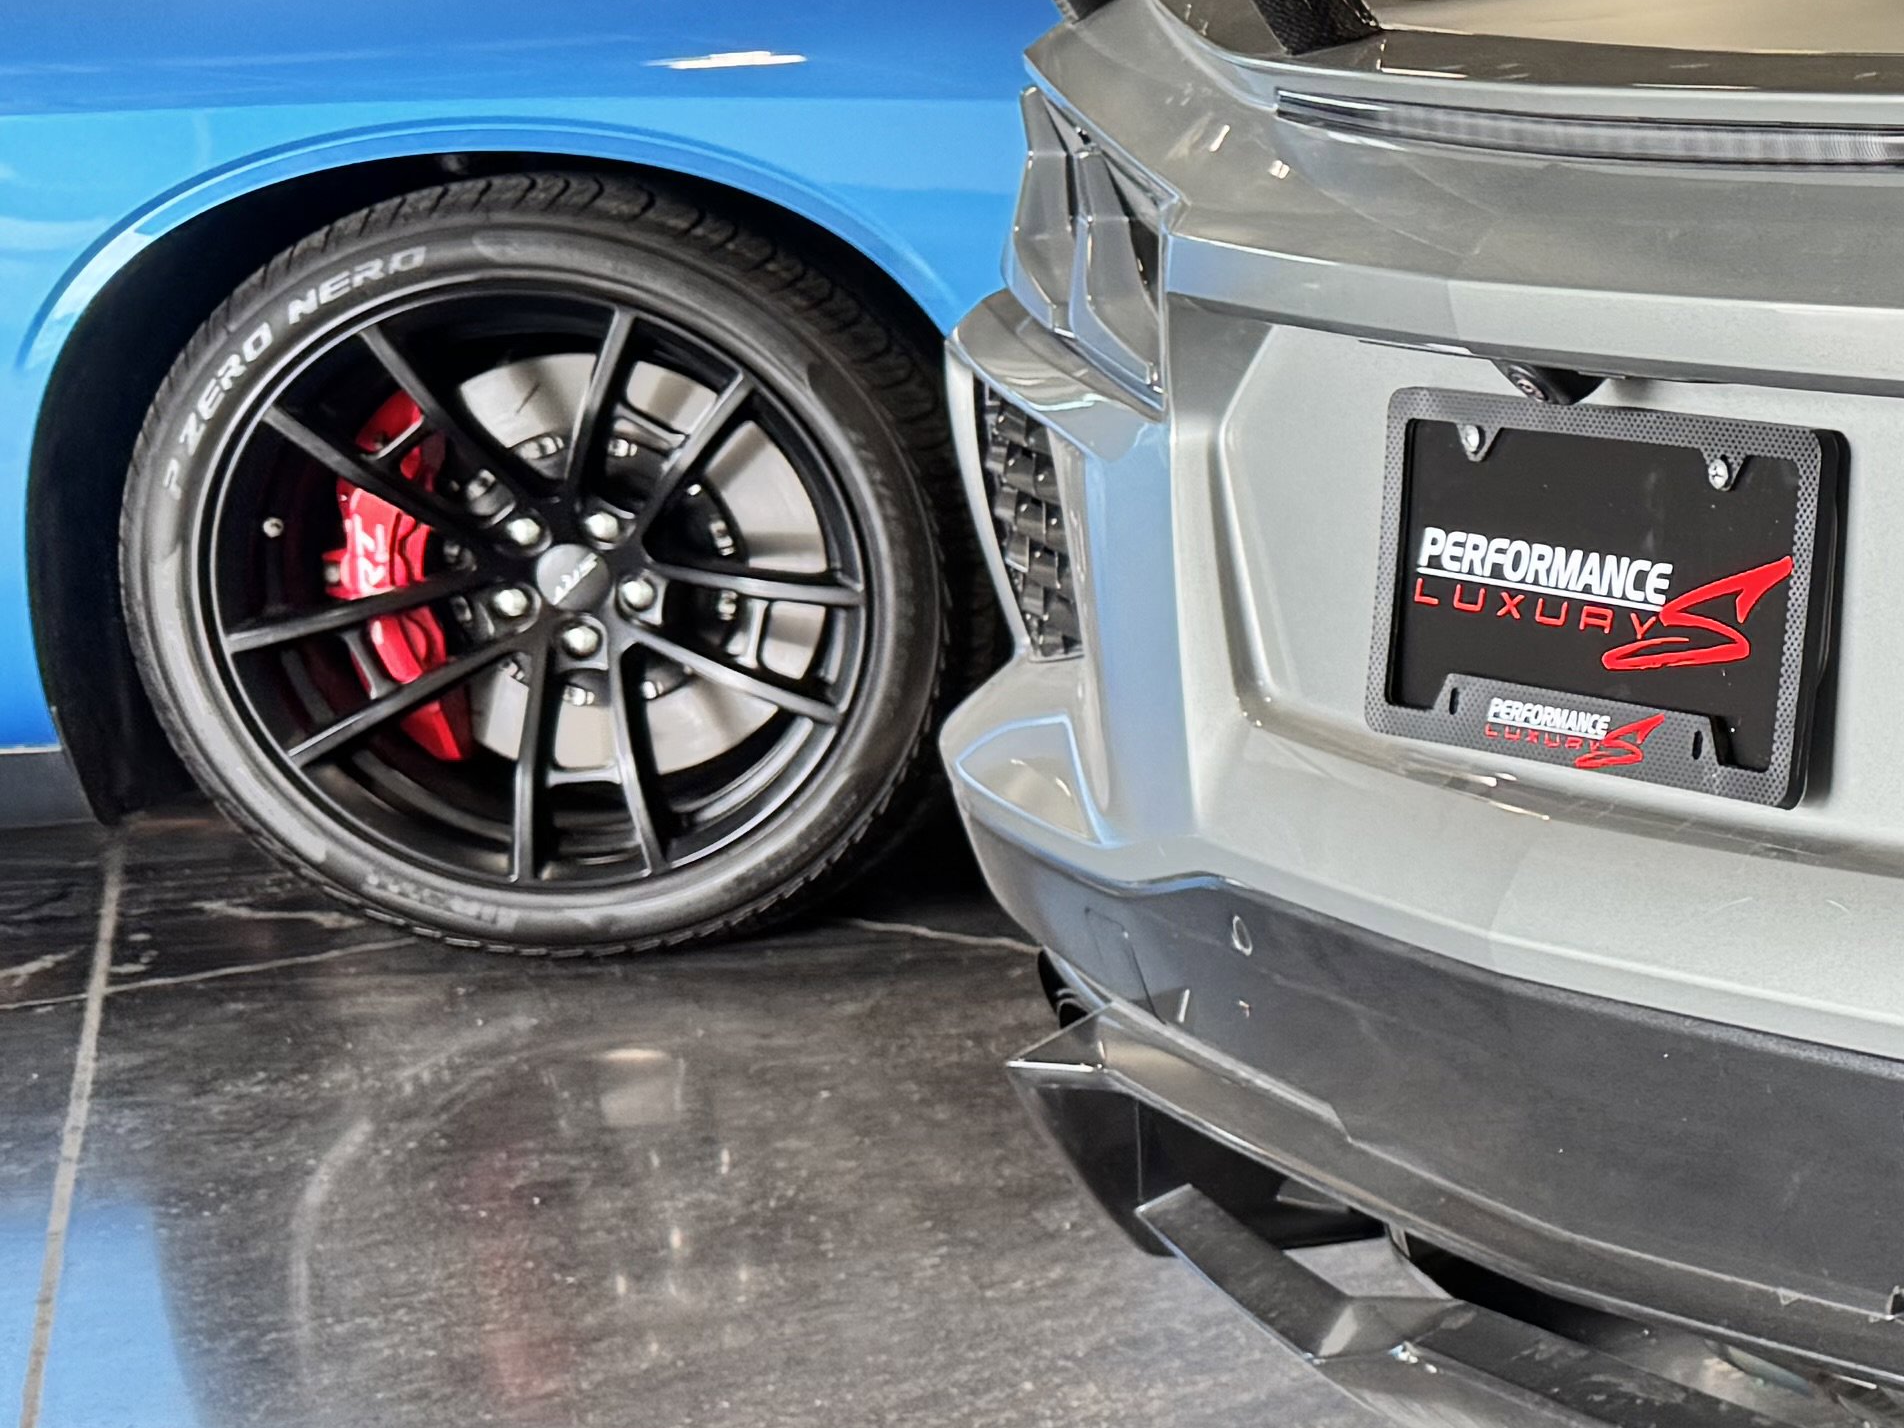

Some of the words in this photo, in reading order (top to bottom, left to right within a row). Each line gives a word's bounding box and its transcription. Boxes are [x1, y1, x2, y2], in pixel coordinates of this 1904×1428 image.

[179, 322, 273, 457] ZERO
[288, 246, 427, 324] NERO
[1418, 527, 1673, 604] PERFORMANCE
[1413, 577, 1657, 640] LUXURY
[1488, 697, 1612, 736] PERFORMANCE
